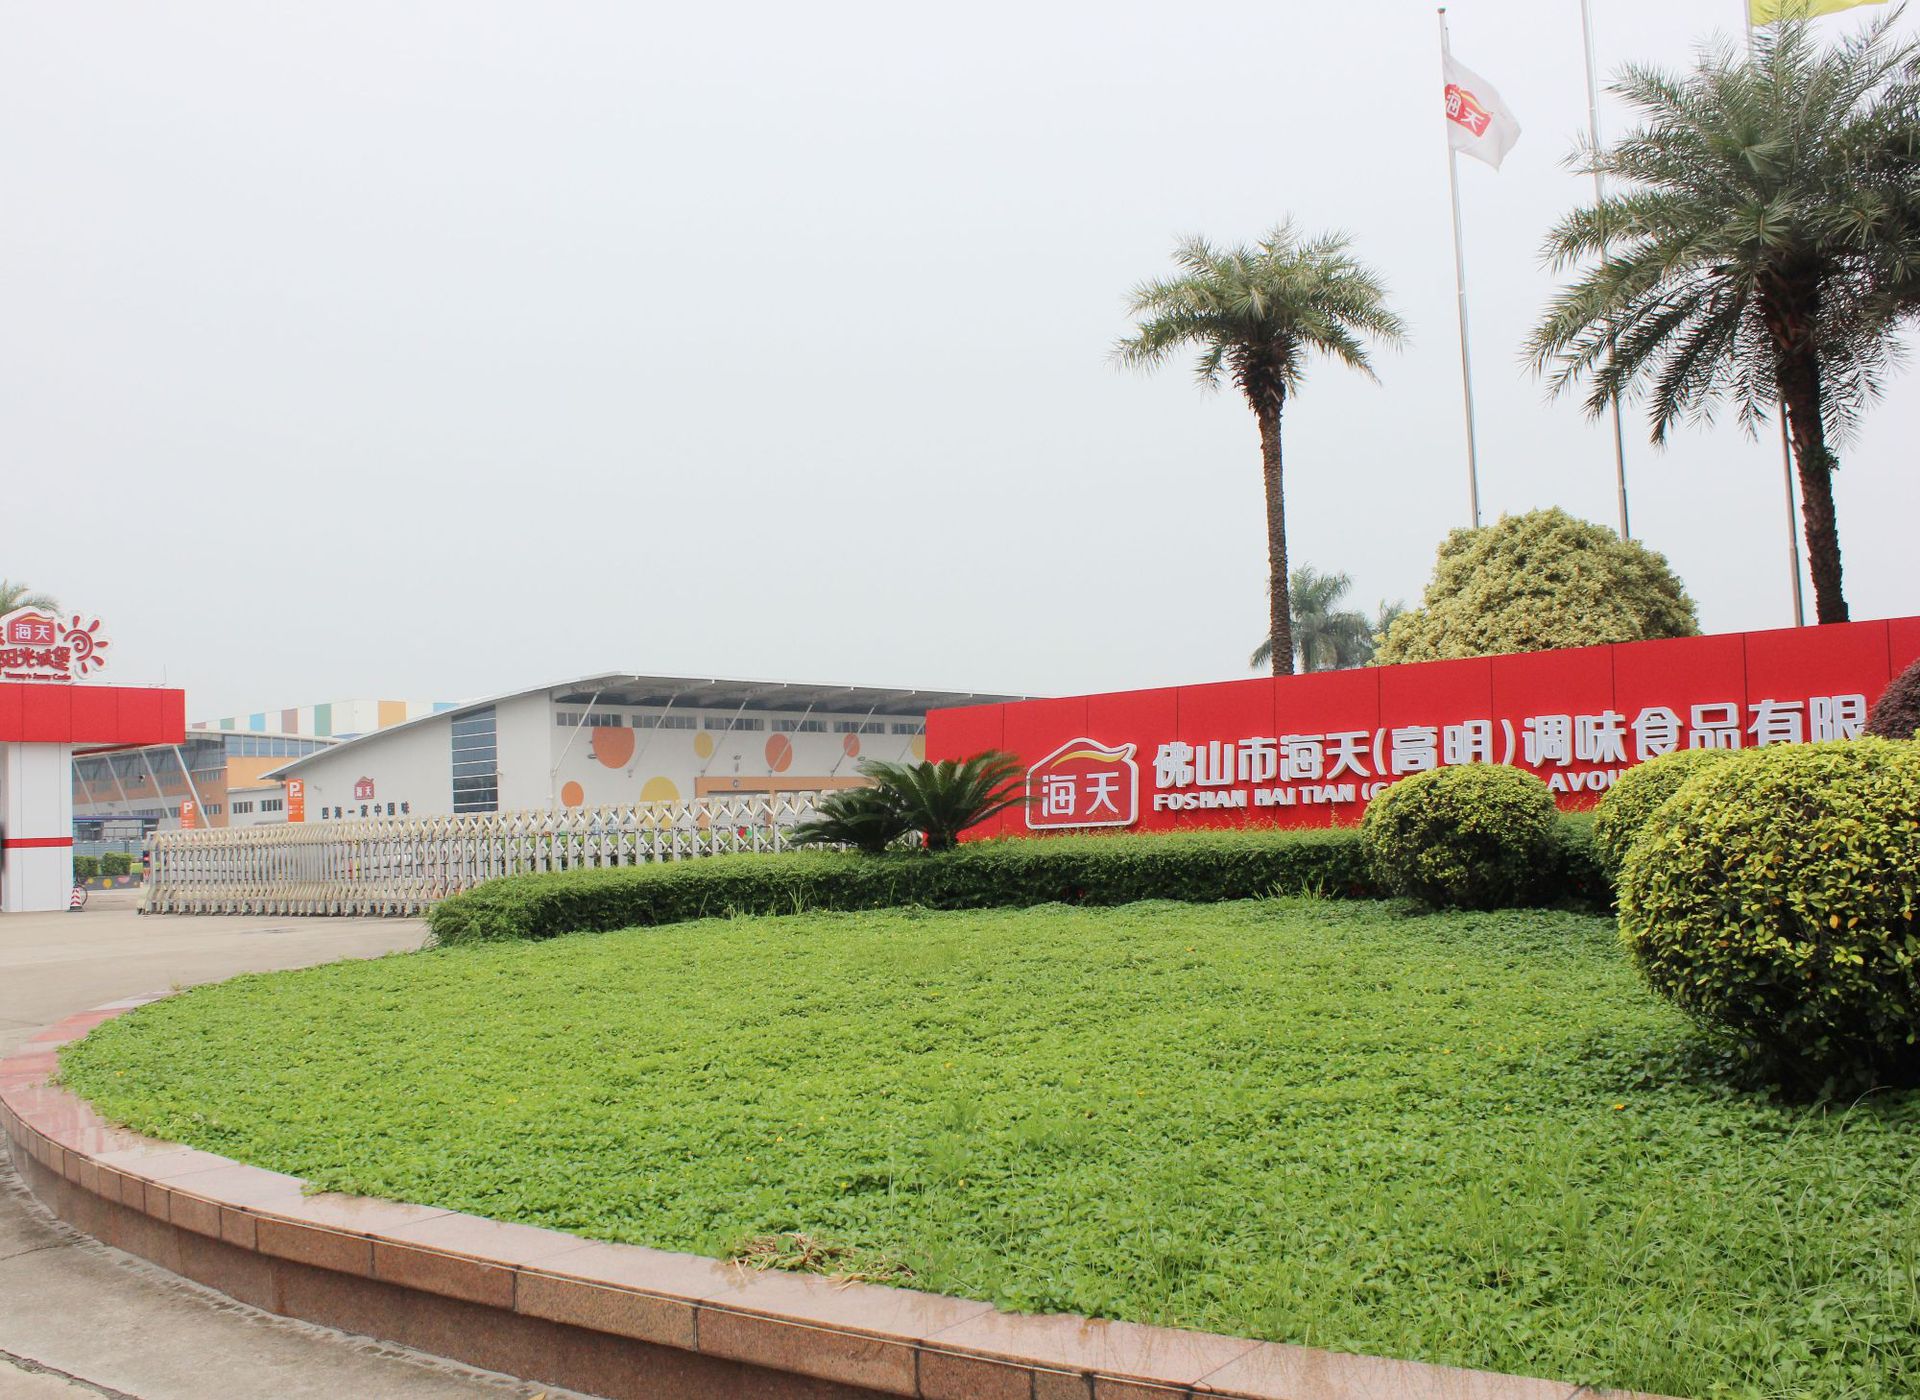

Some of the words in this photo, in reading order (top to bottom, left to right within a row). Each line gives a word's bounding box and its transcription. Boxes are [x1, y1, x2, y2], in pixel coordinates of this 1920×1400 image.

[15, 623, 51, 641] 海天
[289, 782, 301, 797] P
[1042, 771, 1120, 818] 海天
[1153, 789, 1248, 811] FOSHAN
